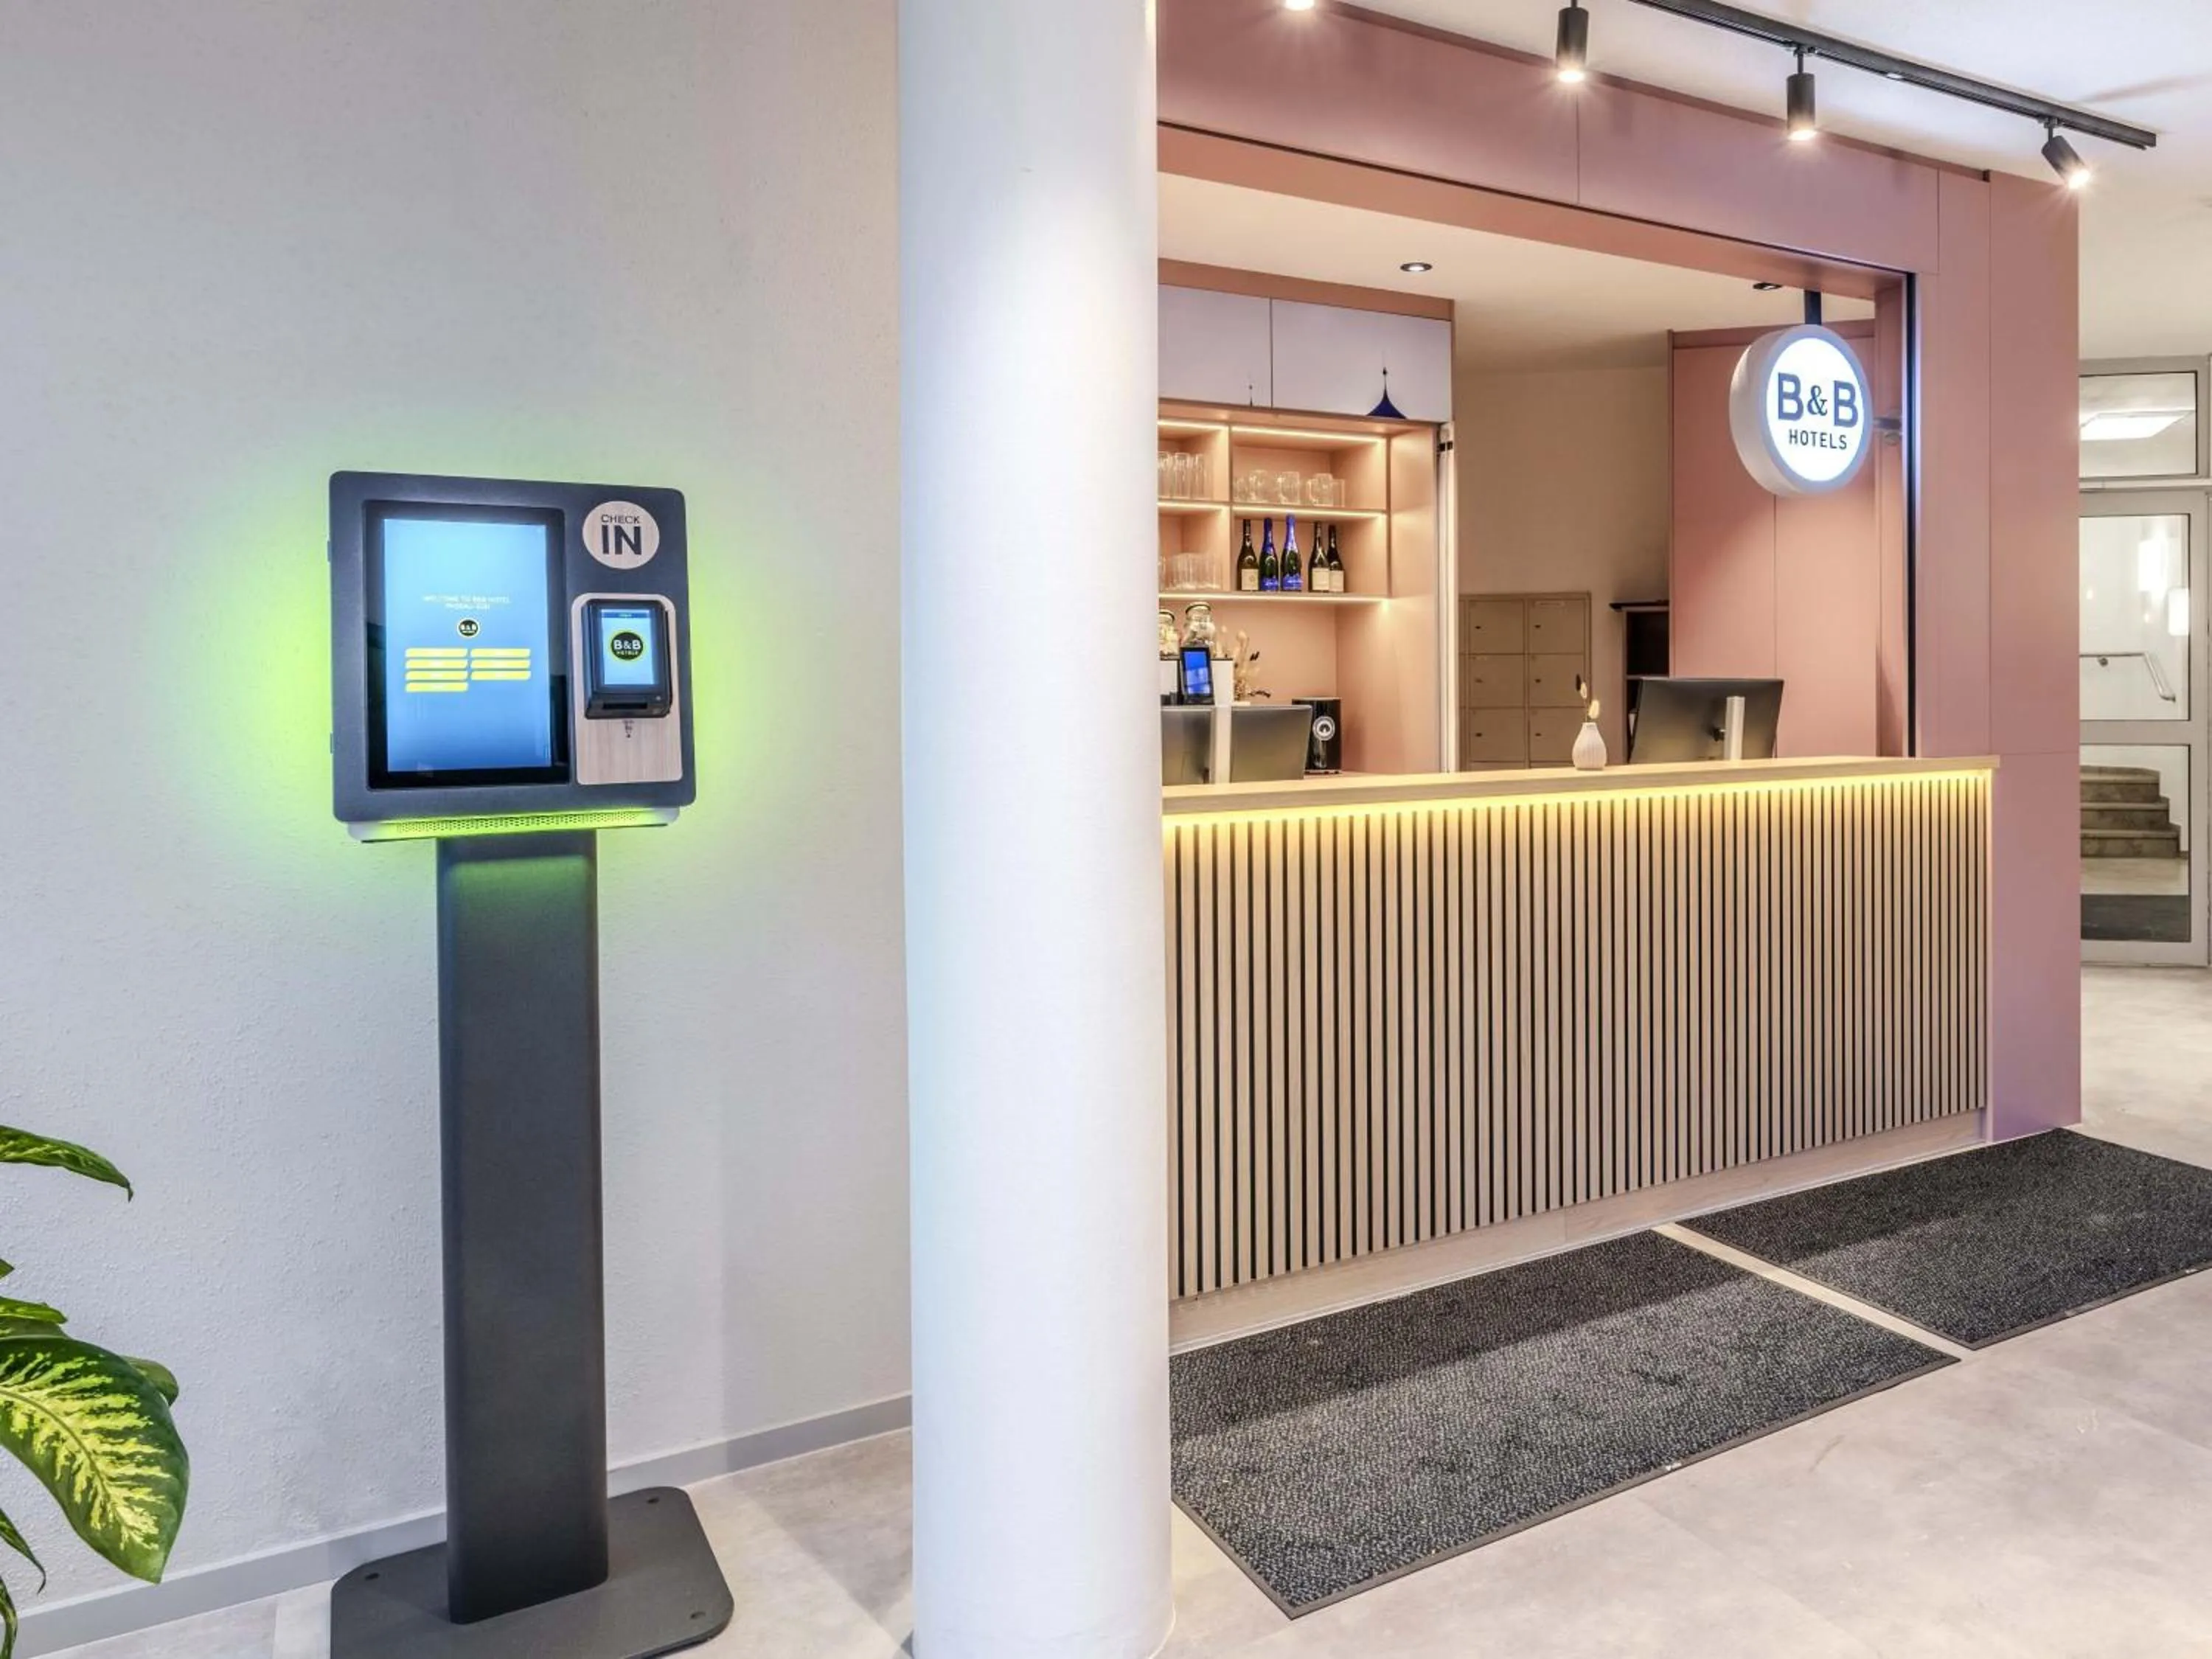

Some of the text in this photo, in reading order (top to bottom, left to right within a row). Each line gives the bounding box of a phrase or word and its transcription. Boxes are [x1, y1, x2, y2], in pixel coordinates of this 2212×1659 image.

[1778, 372, 1859, 428] B&B
[1789, 429, 1847, 450] HOTELS
[601, 515, 641, 524] CHECK
[602, 524, 642, 555] IN
[613, 639, 641, 650] B&B
